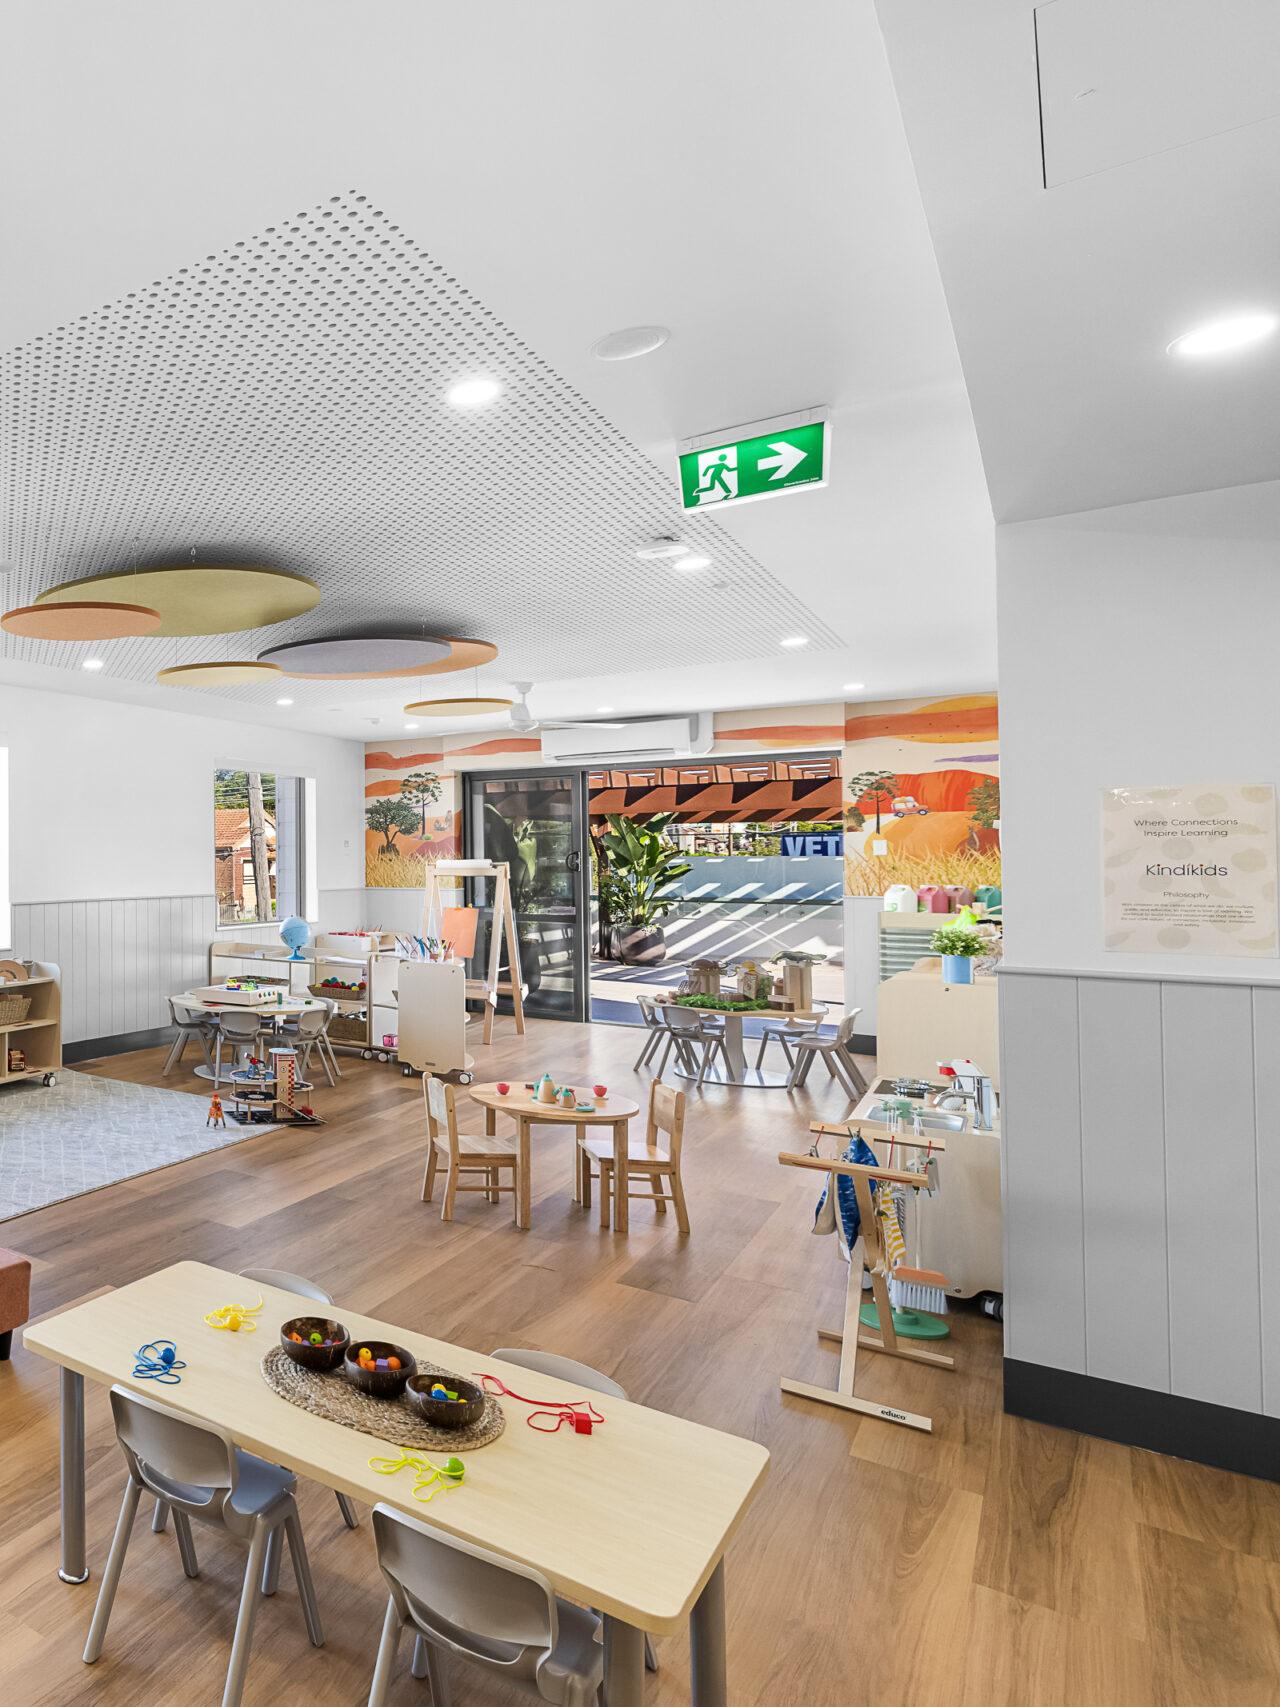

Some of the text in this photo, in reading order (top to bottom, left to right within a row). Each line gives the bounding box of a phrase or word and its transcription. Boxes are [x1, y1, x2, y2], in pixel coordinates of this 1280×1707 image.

[1134, 818, 1239, 827] Where Connections
[1143, 829, 1228, 838] Inspire Learning
[784, 836, 840, 857] VET
[1163, 891, 1210, 900] Philosophy
